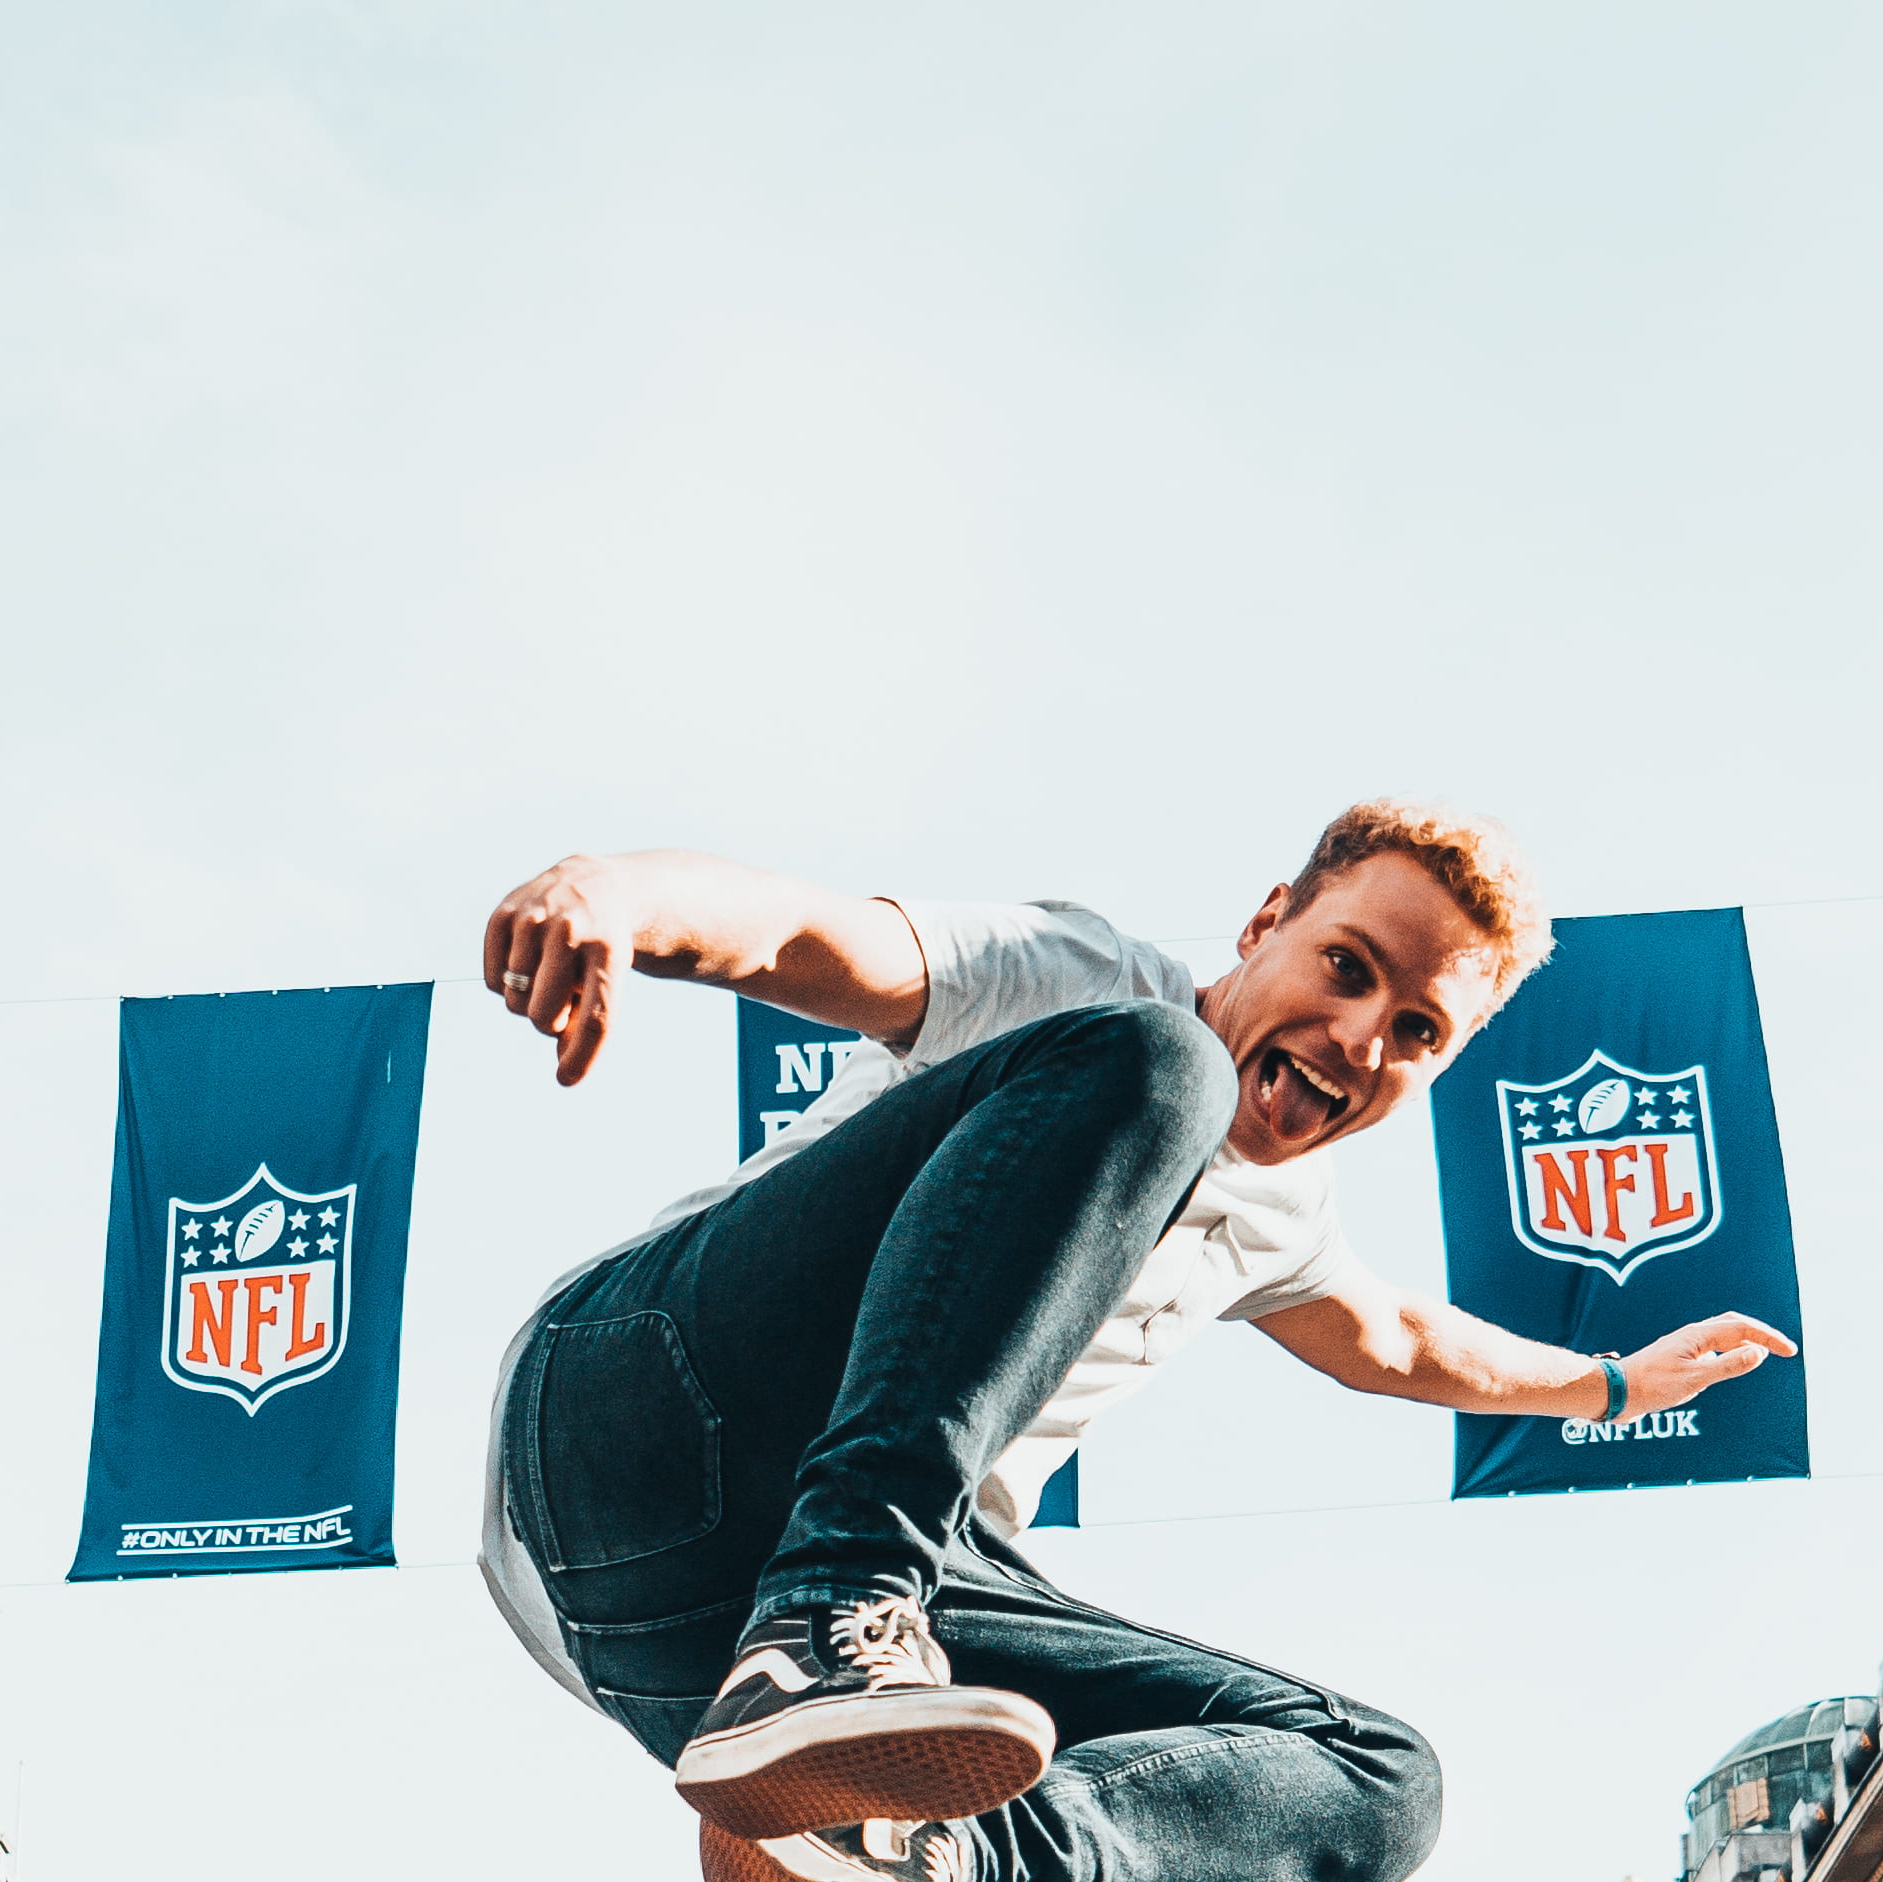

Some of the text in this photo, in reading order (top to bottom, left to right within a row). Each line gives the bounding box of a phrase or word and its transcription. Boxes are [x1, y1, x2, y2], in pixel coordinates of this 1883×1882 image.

[1533, 1143, 1694, 1242] NFL
[185, 1272, 325, 1376] NFL
[121, 1516, 352, 1549] #ONLY IN THE NFL
